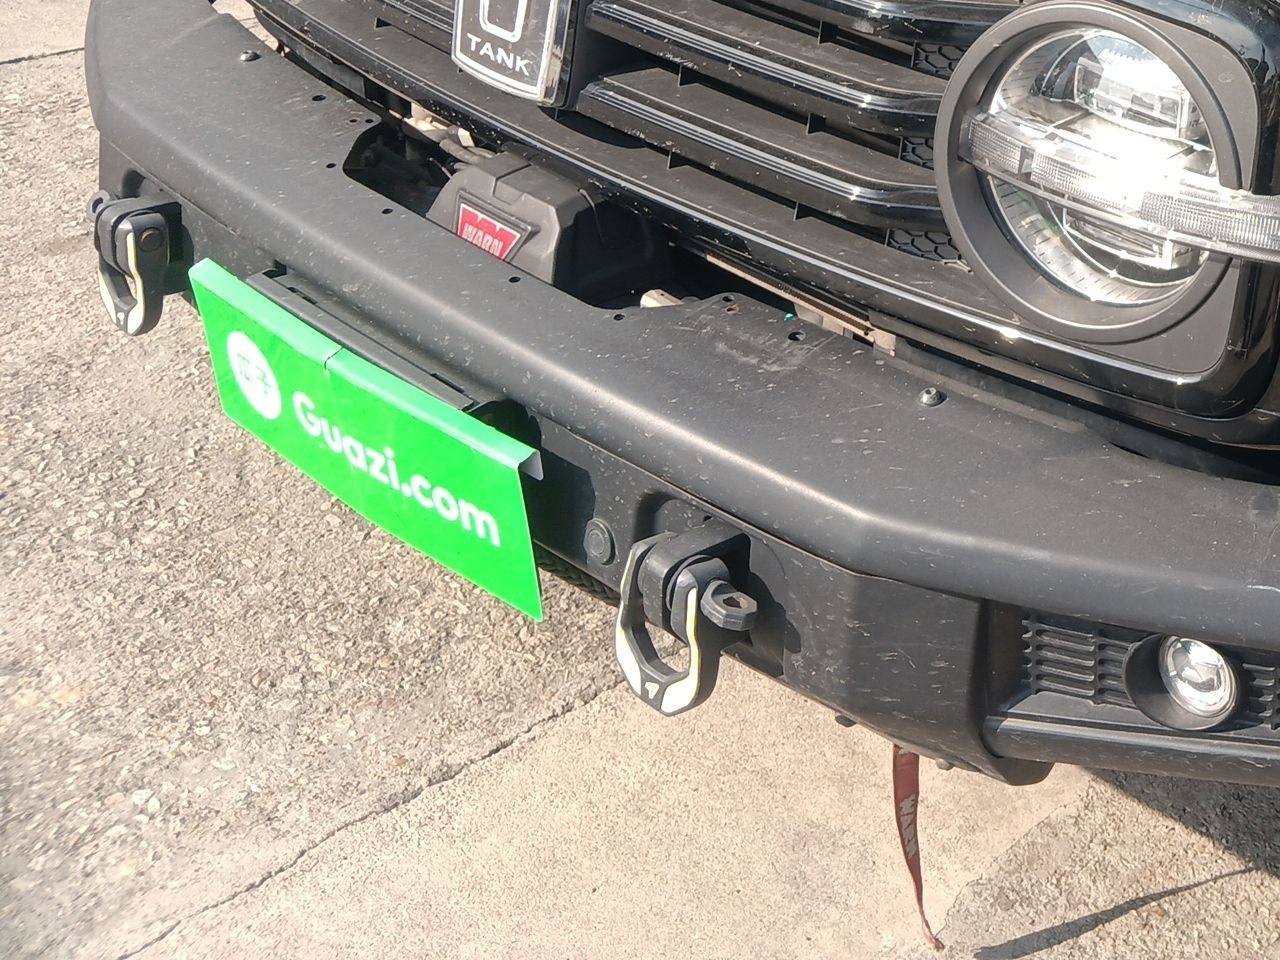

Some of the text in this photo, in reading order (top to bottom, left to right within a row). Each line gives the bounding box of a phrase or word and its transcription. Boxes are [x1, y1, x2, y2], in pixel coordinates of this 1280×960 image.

[466, 32, 535, 77] TANK
[461, 222, 504, 258] WARN
[292, 390, 501, 548] Guazi.com
